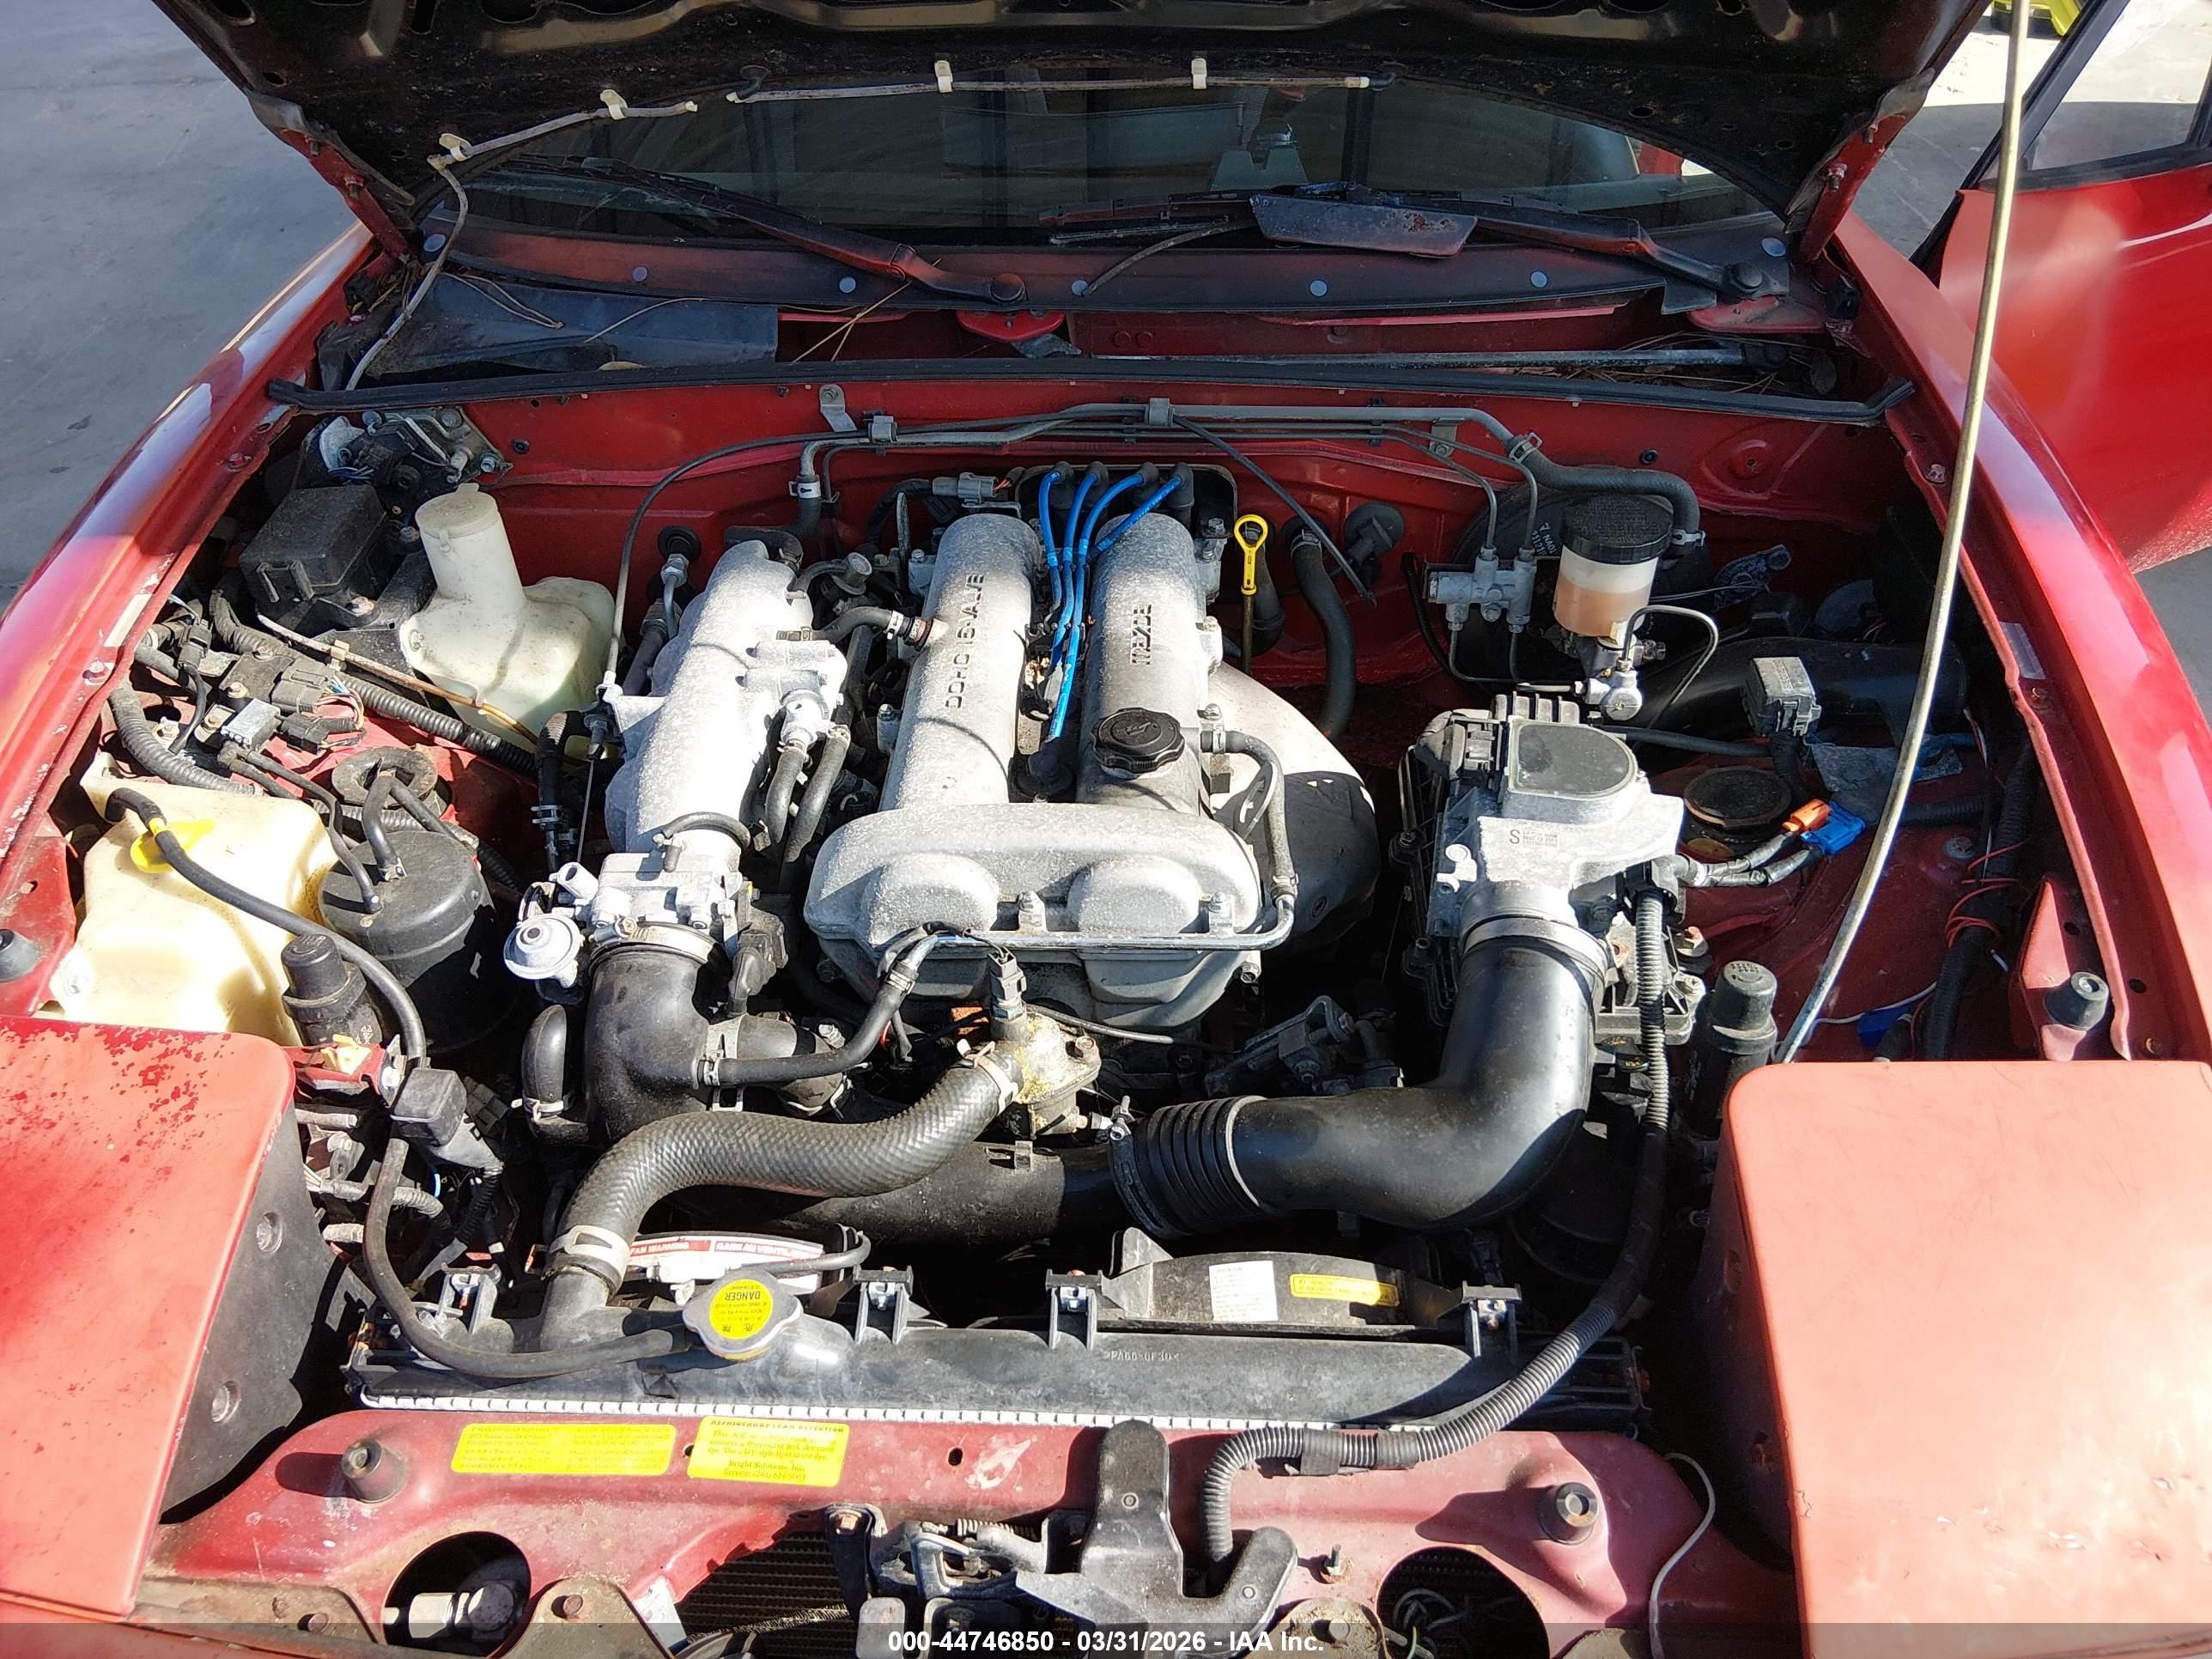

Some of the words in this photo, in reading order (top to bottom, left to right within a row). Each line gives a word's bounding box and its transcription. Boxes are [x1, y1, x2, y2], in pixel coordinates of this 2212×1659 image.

[647, 1242, 690, 1253] WARNING
[725, 1291, 762, 1301] DANGER
[727, 1459, 752, 1468] Bright
[791, 1462, 805, 1472] Inc.
